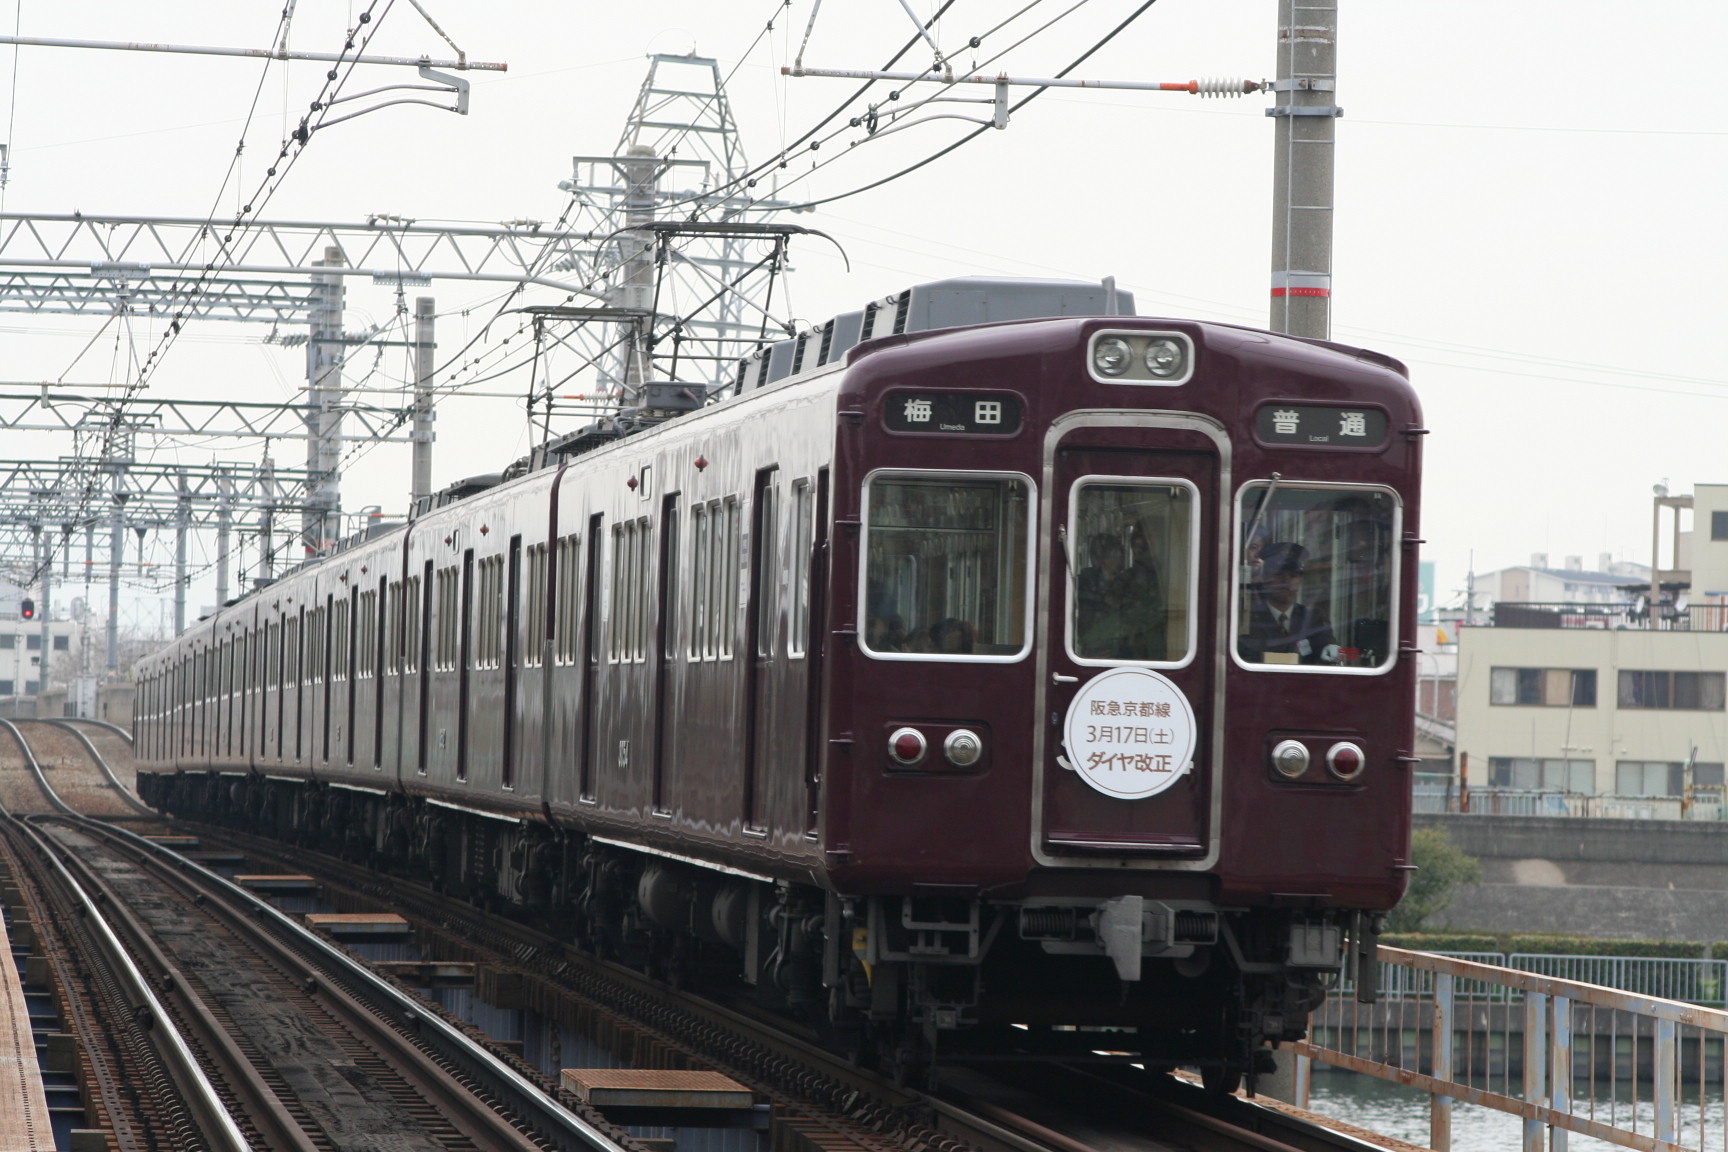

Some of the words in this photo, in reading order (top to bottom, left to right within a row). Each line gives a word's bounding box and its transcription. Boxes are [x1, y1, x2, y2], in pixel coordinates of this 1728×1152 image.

[903, 398, 1002, 424] 梅田
[939, 423, 965, 431] Umeda
[1272, 409, 1367, 437] 普通
[1309, 434, 1329, 442] Local
[1090, 700, 1172, 718] 阪急京都線
[1086, 725, 1174, 745] 3月17日(土)
[1086, 751, 1173, 773] ダイヤ改正
